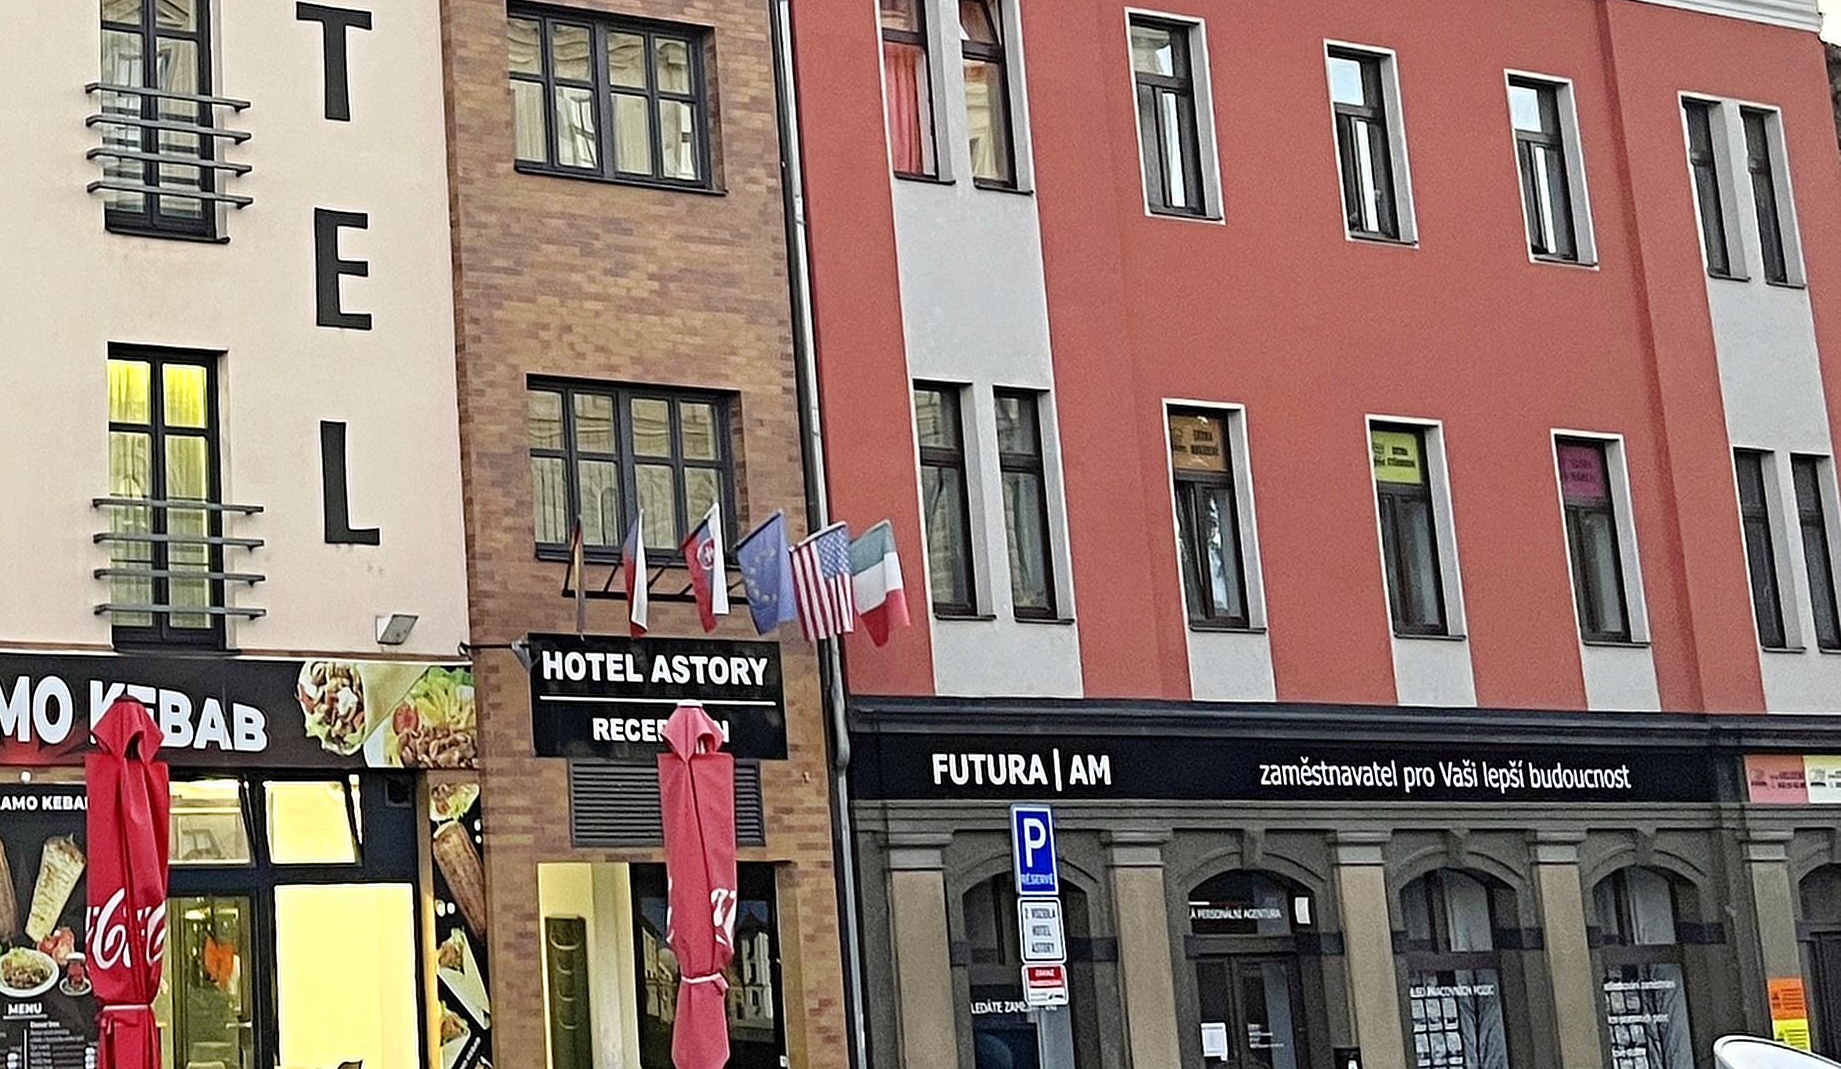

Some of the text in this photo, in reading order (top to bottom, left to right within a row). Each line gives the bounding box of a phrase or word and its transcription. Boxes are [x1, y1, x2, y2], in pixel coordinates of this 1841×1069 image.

[541, 650, 769, 686] HOTEL ASTORY
[931, 753, 1113, 786] FUTURA AM
[1259, 757, 1632, 794] zaměstnavatel pro Vaši lepší budoucnost
[41, 795, 89, 811] KEBA
[1022, 817, 1047, 868] P
[7, 1002, 43, 1015] MENU
[969, 998, 1004, 1014] LEDÁTE
